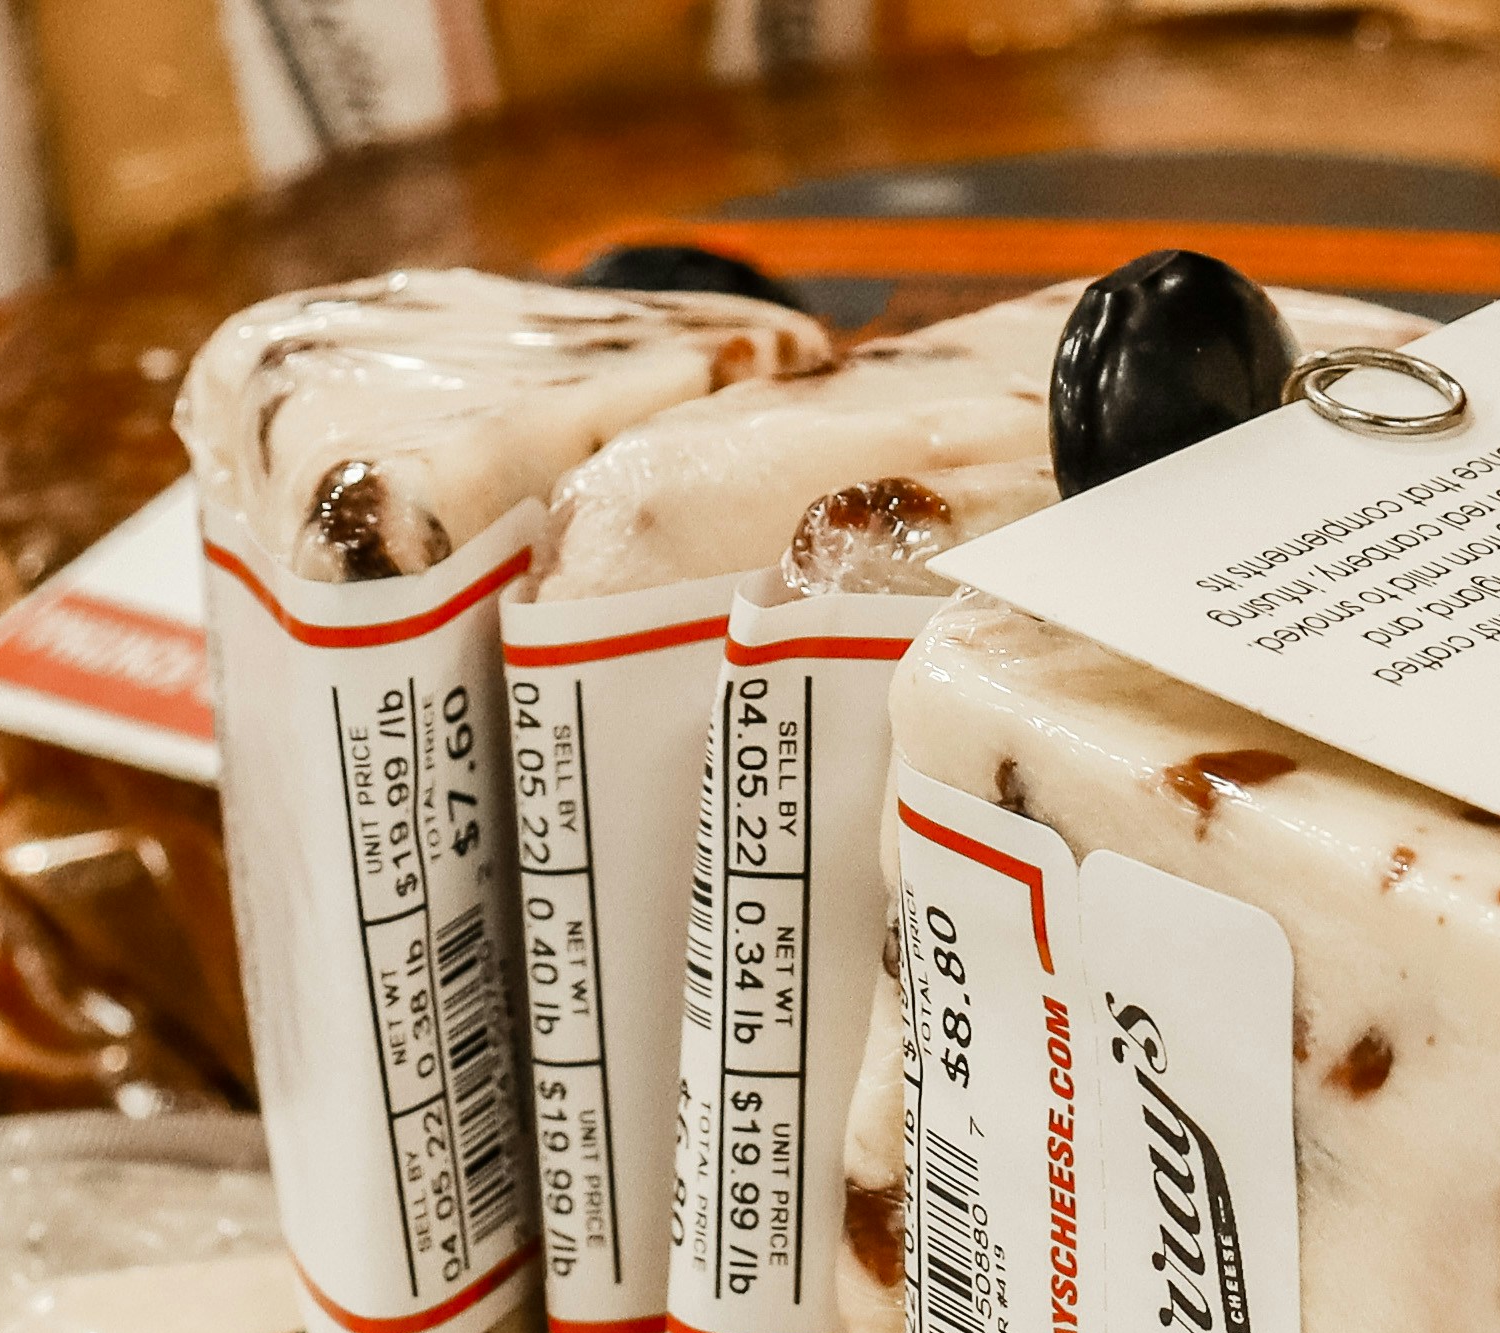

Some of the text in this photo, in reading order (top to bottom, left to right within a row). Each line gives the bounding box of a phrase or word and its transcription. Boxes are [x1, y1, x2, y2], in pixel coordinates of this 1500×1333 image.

[1252, 599, 1365, 655] smoked.
[1356, 585, 1403, 604] to
[1360, 615, 1424, 649] and
[1385, 560, 1451, 595] mild
[1371, 634, 1475, 686] crafted
[511, 681, 551, 872] 04.05.22
[735, 677, 768, 867] 04.05.22
[777, 720, 798, 837] SELL BY
[525, 896, 561, 1036] 0.40 lb
[732, 900, 766, 1045] 0.34 lb
[773, 925, 795, 1028] NET WT
[925, 904, 972, 1089] $8.80
[535, 1080, 577, 1277] $19.99 /lb
[968, 1114, 985, 1138] 7
[727, 1090, 763, 1295] $19.99 /lb
[768, 1122, 791, 1266] UNIT PRICE
[971, 1202, 993, 1320] 50880
[1220, 1233, 1244, 1325] CHEESE
